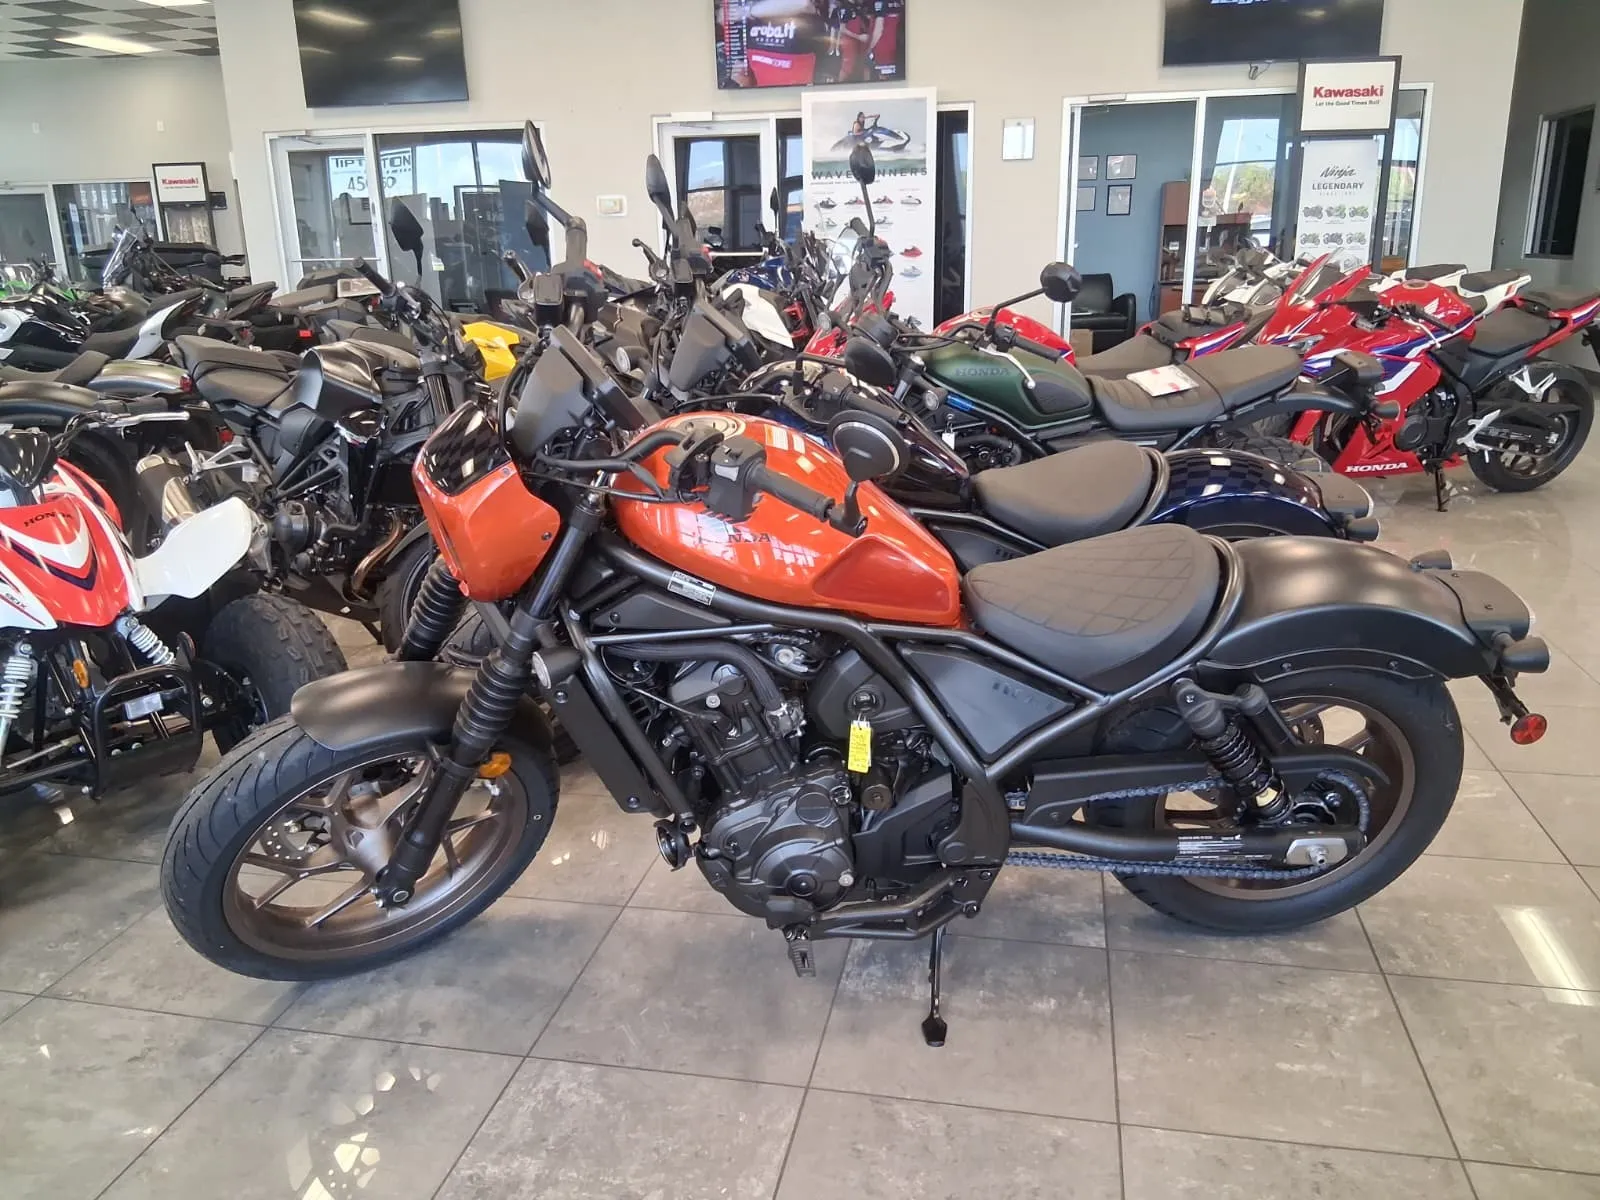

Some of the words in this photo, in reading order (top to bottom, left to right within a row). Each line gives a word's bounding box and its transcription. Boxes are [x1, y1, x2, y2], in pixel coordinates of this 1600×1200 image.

[1313, 85, 1384, 98] Kawasaki
[812, 168, 927, 179] WAVENNERS
[1320, 165, 1357, 179] Ninja
[1312, 182, 1364, 191] LEGENDARY
[955, 368, 1010, 377] HONDA
[1345, 462, 1408, 473] HONDA
